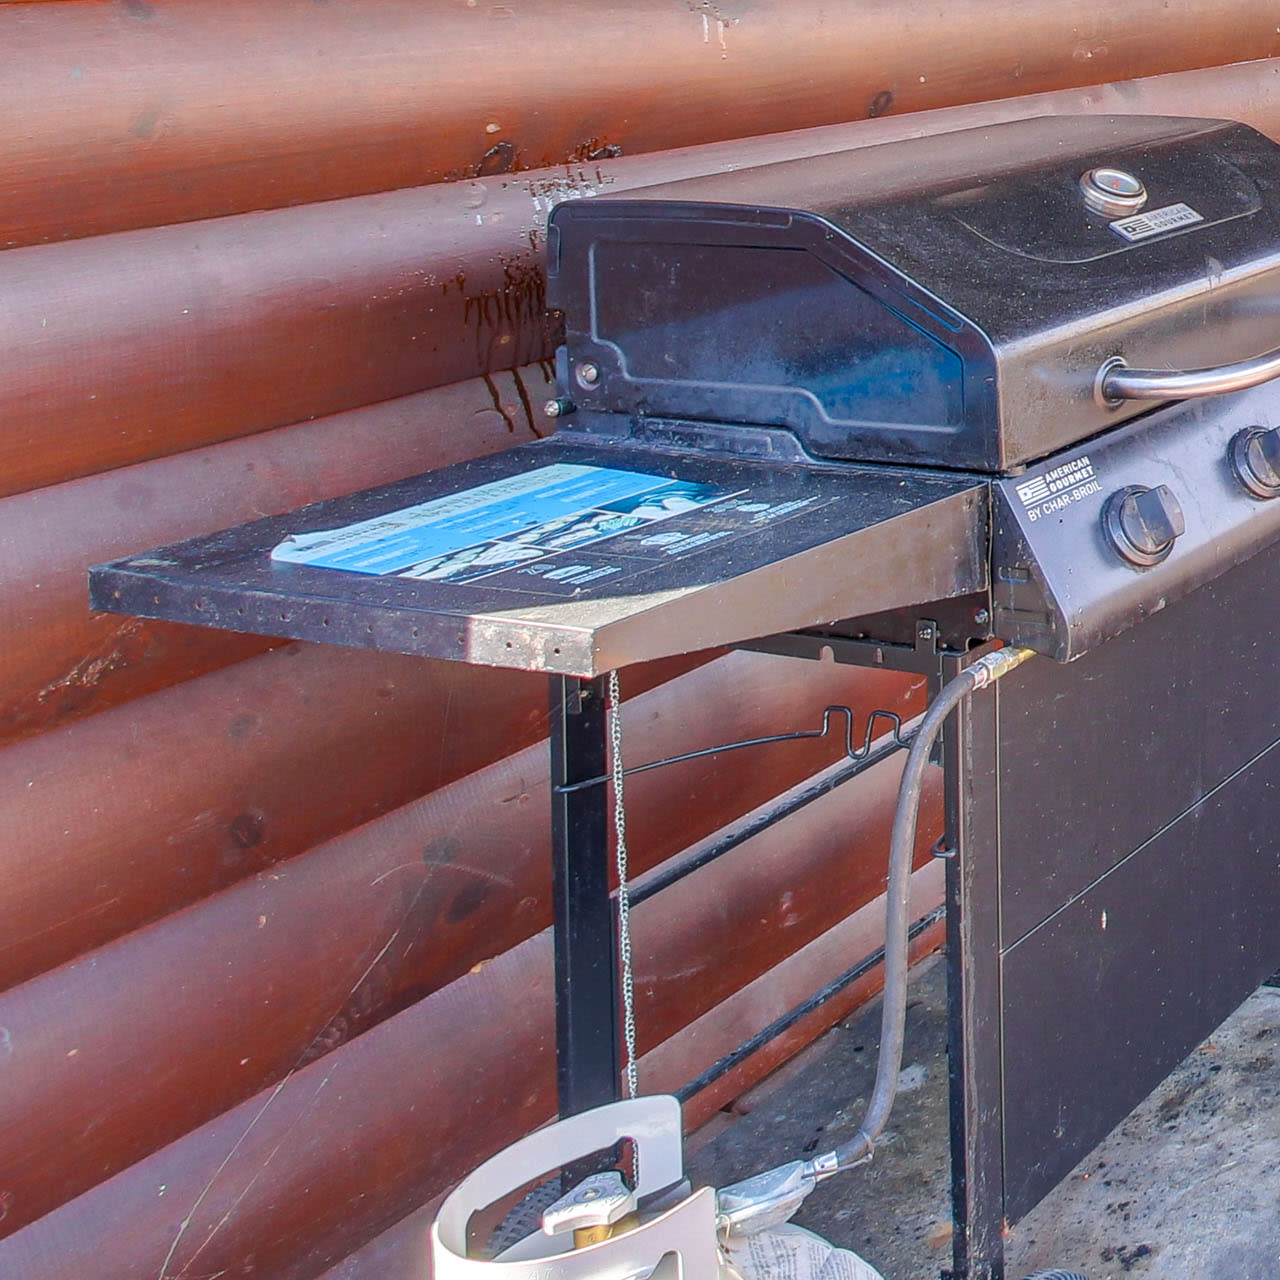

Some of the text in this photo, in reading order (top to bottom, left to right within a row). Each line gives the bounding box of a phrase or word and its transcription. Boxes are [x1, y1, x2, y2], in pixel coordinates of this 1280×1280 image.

[1045, 456, 1090, 483] AMERICAN
[1049, 465, 1094, 492] GOURMET
[1027, 480, 1104, 522] BY CHAR-BROIL
